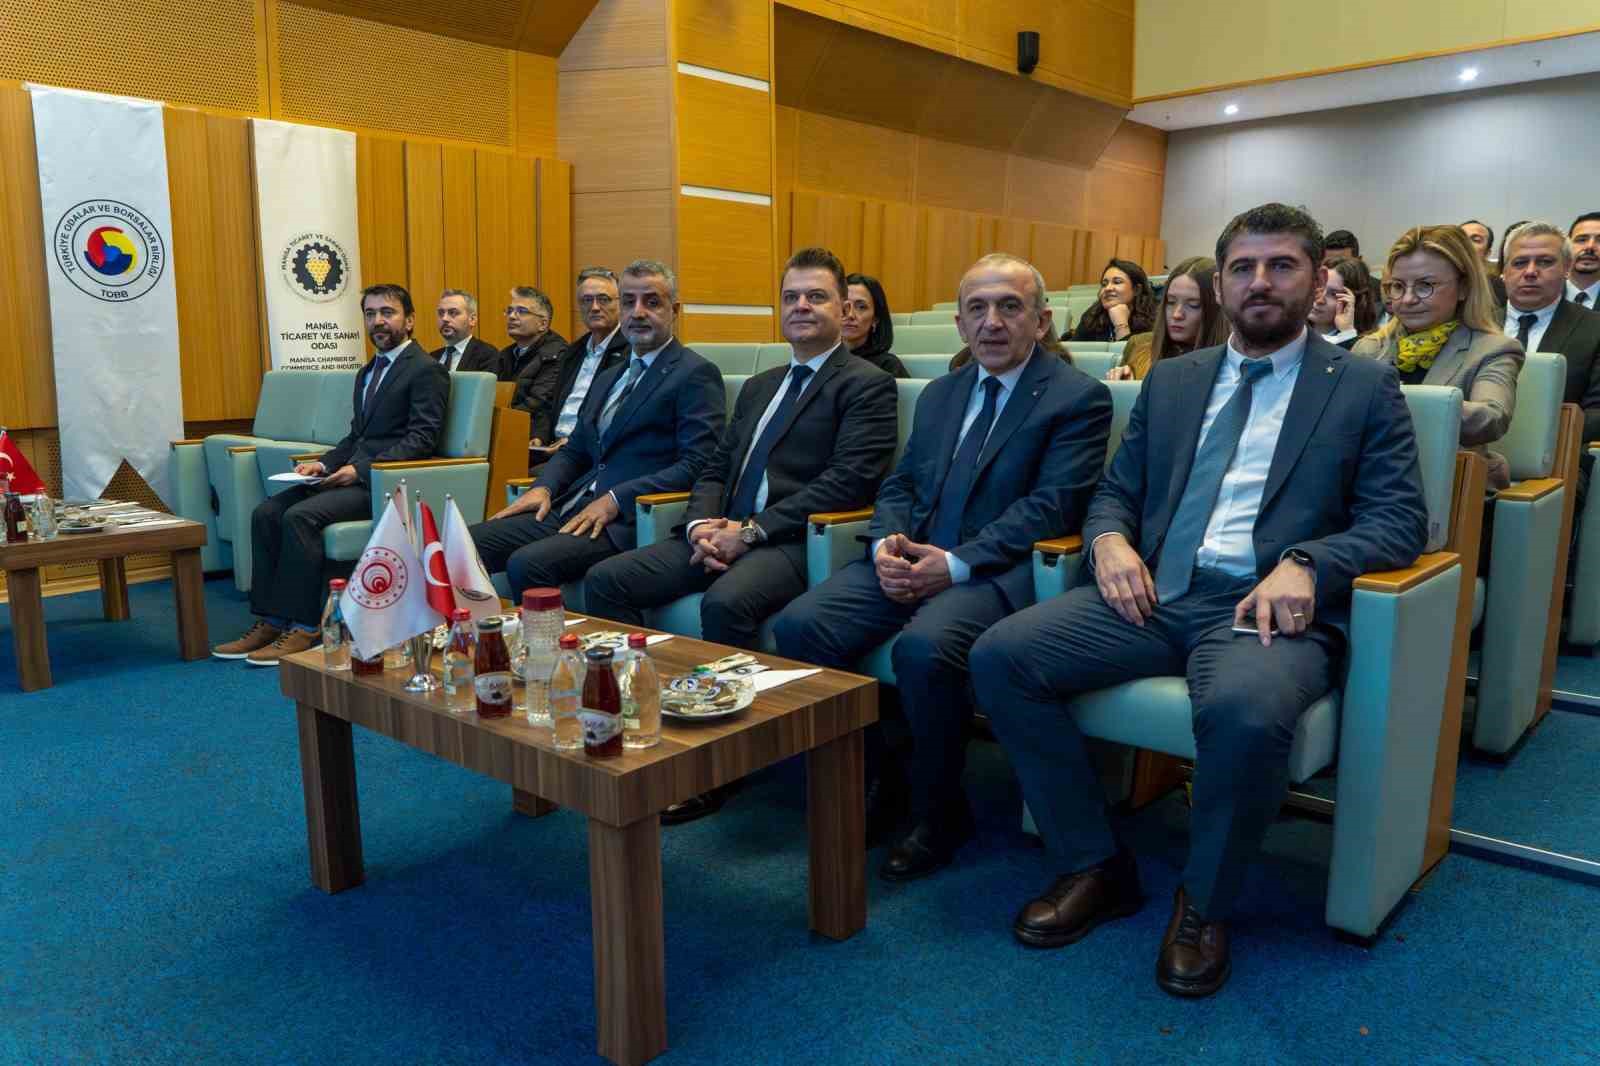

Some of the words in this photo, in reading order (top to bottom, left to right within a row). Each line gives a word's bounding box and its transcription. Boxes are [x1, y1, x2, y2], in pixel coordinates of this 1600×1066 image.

[97, 204, 110, 213] VE
[64, 205, 96, 231] ODALAR
[113, 206, 156, 244] BORSALAR
[58, 233, 75, 274] TÜRKİYE
[101, 289, 129, 298] TOBB
[305, 321, 339, 330] MANİSA
[280, 331, 318, 340] TİCARET
[320, 332, 333, 340] VE
[334, 330, 360, 340] SANAYİ
[311, 342, 338, 350] ODASI
